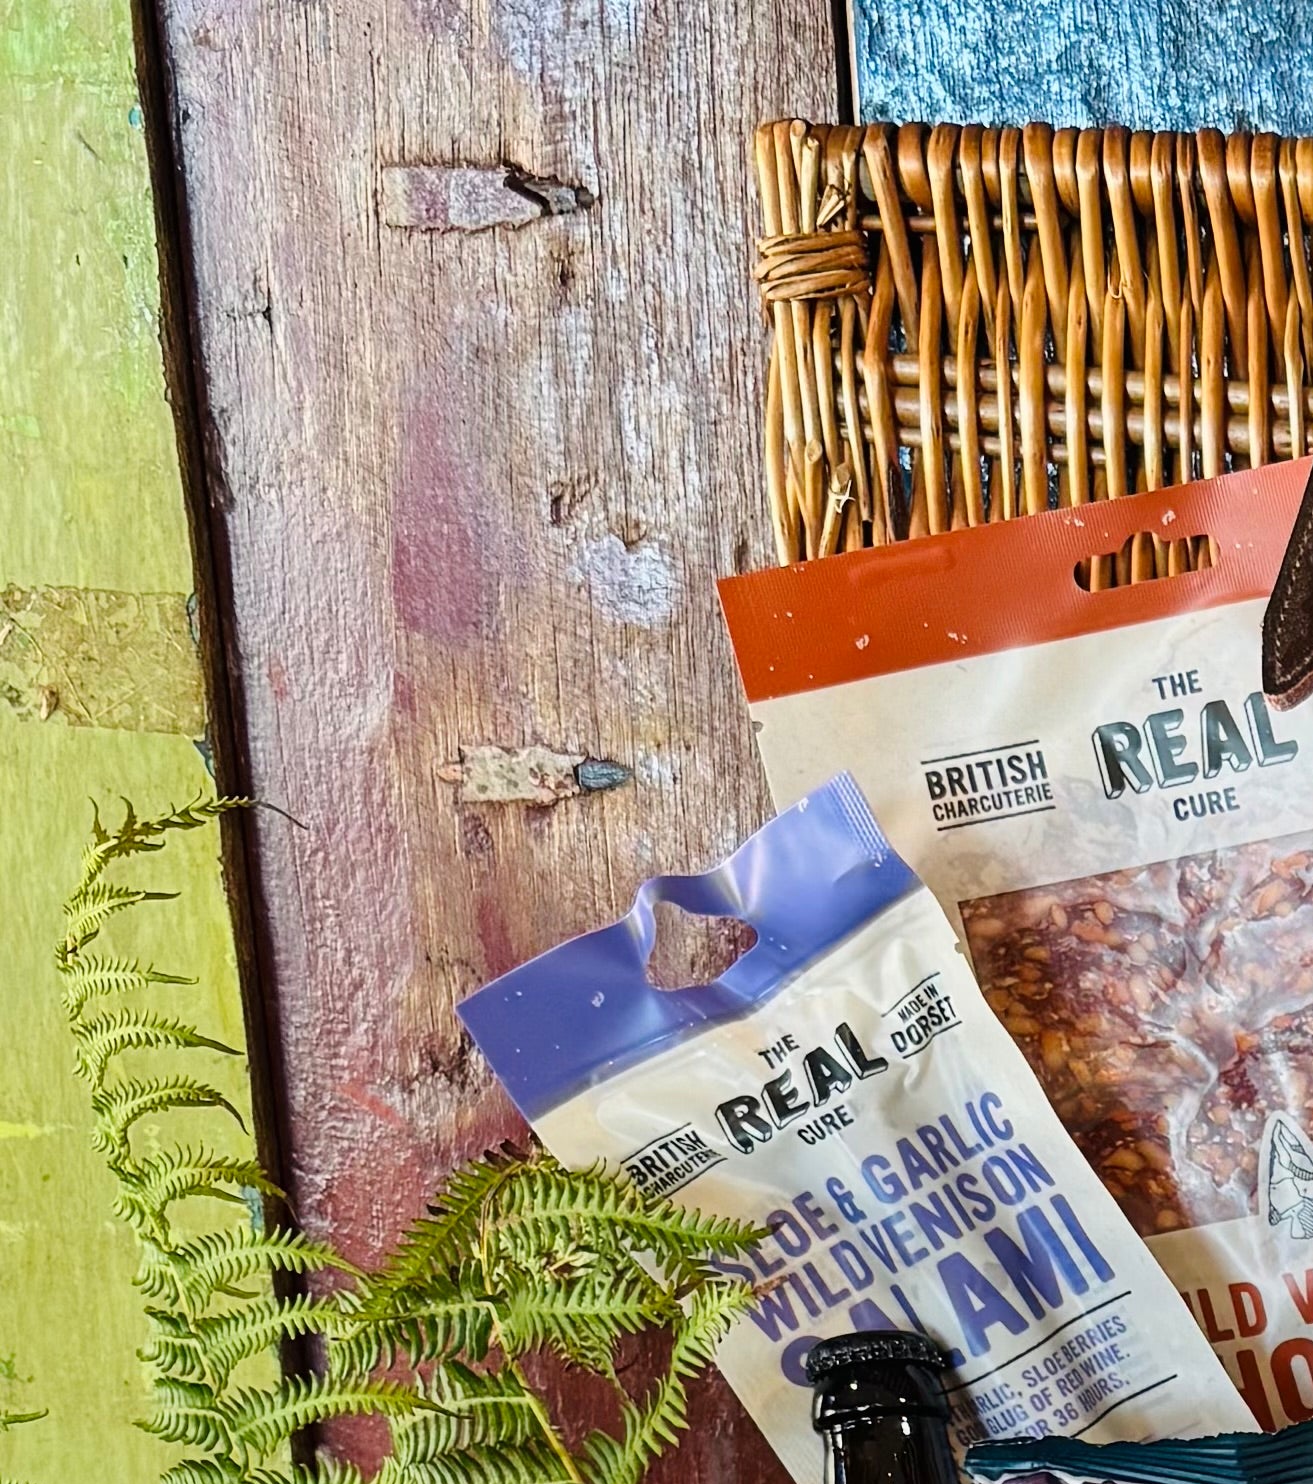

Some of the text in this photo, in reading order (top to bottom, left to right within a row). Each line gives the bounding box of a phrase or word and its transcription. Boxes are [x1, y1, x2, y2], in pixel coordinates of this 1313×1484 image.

[1152, 669, 1204, 700] THE
[925, 751, 1048, 802] BRITISH
[1090, 690, 1298, 800] REAL
[1173, 787, 1241, 821] CURE
[715, 1022, 888, 1154] REAL
[797, 1105, 854, 1146] CURE
[860, 1091, 1015, 1206] GARLIC
[862, 1142, 1056, 1269] VENISON
